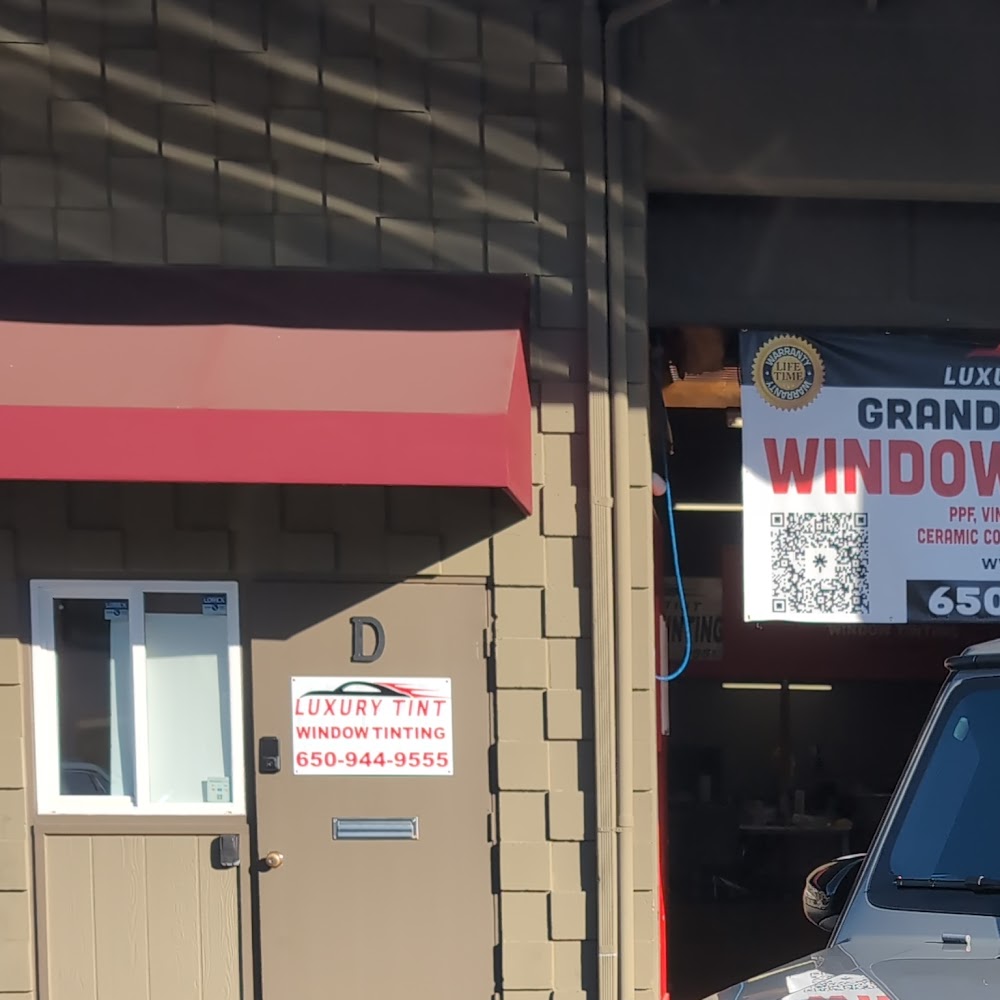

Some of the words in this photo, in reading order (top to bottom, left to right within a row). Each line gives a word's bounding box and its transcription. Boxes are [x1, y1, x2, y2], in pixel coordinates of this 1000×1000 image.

[766, 347, 811, 366] WARRANTY
[776, 361, 801, 372] LIFE
[774, 372, 804, 381] TIME
[766, 381, 812, 400] WARRANTY
[857, 397, 1000, 431] GRAND
[949, 506, 977, 524] PPF,
[917, 528, 979, 545] CERAMIC
[350, 616, 386, 664] D
[295, 698, 383, 717] LUXURY
[392, 699, 447, 717] TINT
[296, 726, 369, 740] WINDOW
[373, 726, 446, 740] TINTING
[296, 751, 449, 768] 650-944-9555
